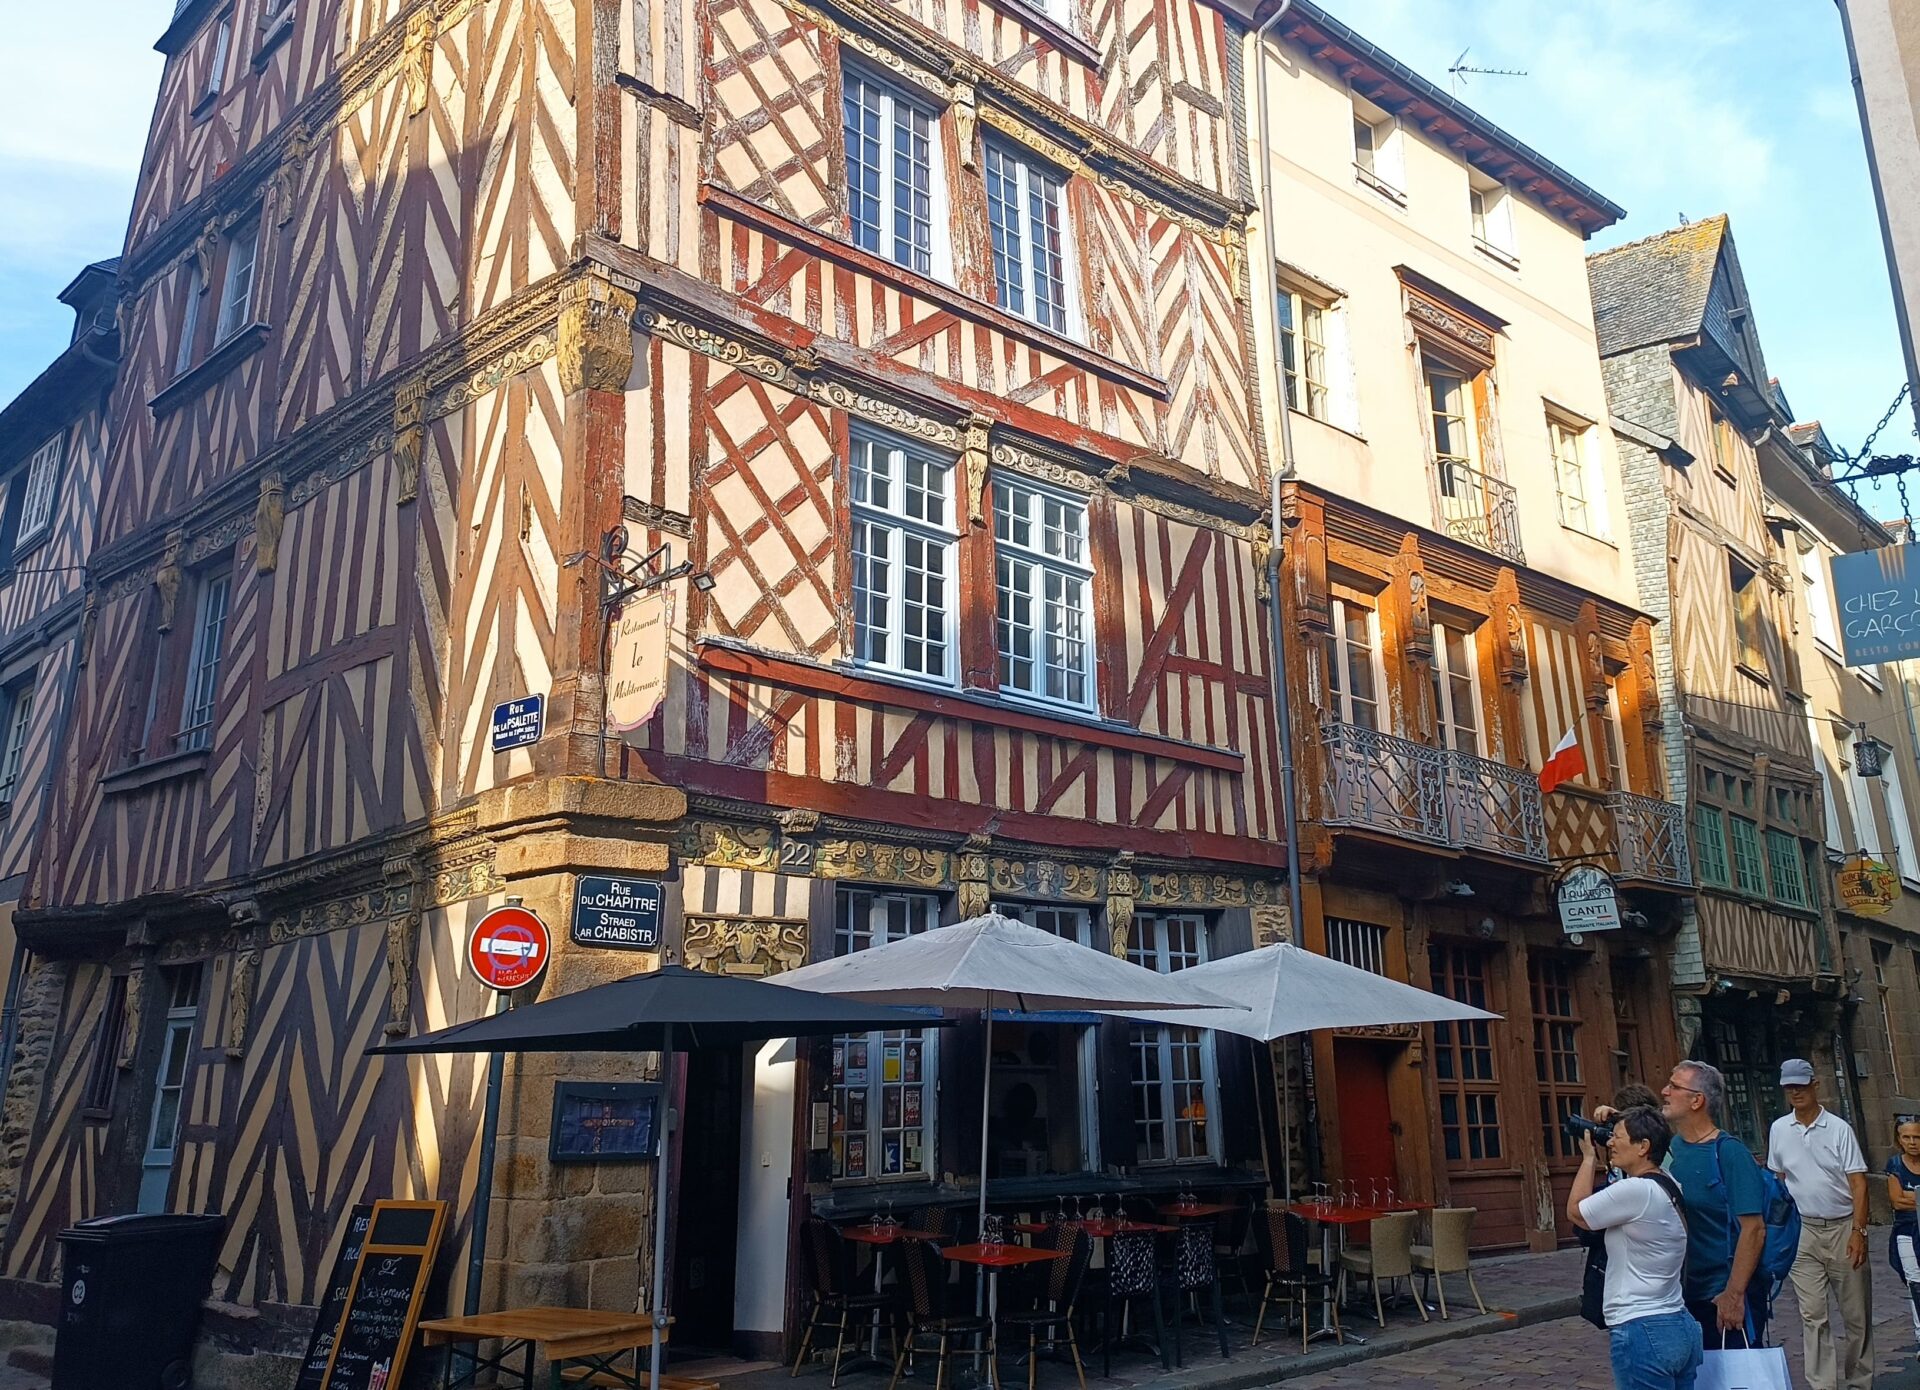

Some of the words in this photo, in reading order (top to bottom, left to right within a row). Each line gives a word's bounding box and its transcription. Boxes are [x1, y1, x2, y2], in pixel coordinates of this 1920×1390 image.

[1844, 589, 1903, 613] CHEZ
[620, 612, 660, 638] Restaurant
[493, 724, 500, 733] DE
[500, 722, 507, 731] LA
[507, 711, 539, 730] PSALETTE
[780, 841, 811, 866] 22
[581, 895, 594, 905] DU
[595, 893, 657, 911] CHAPITRE
[1569, 887, 1611, 899] QUATTRO
[1568, 904, 1608, 917] CANTI
[579, 928, 592, 937] AR
[594, 925, 652, 943] CHABISTR
[1565, 922, 1596, 930] RISTORANTE
[1595, 920, 1618, 928] ITALIANO
